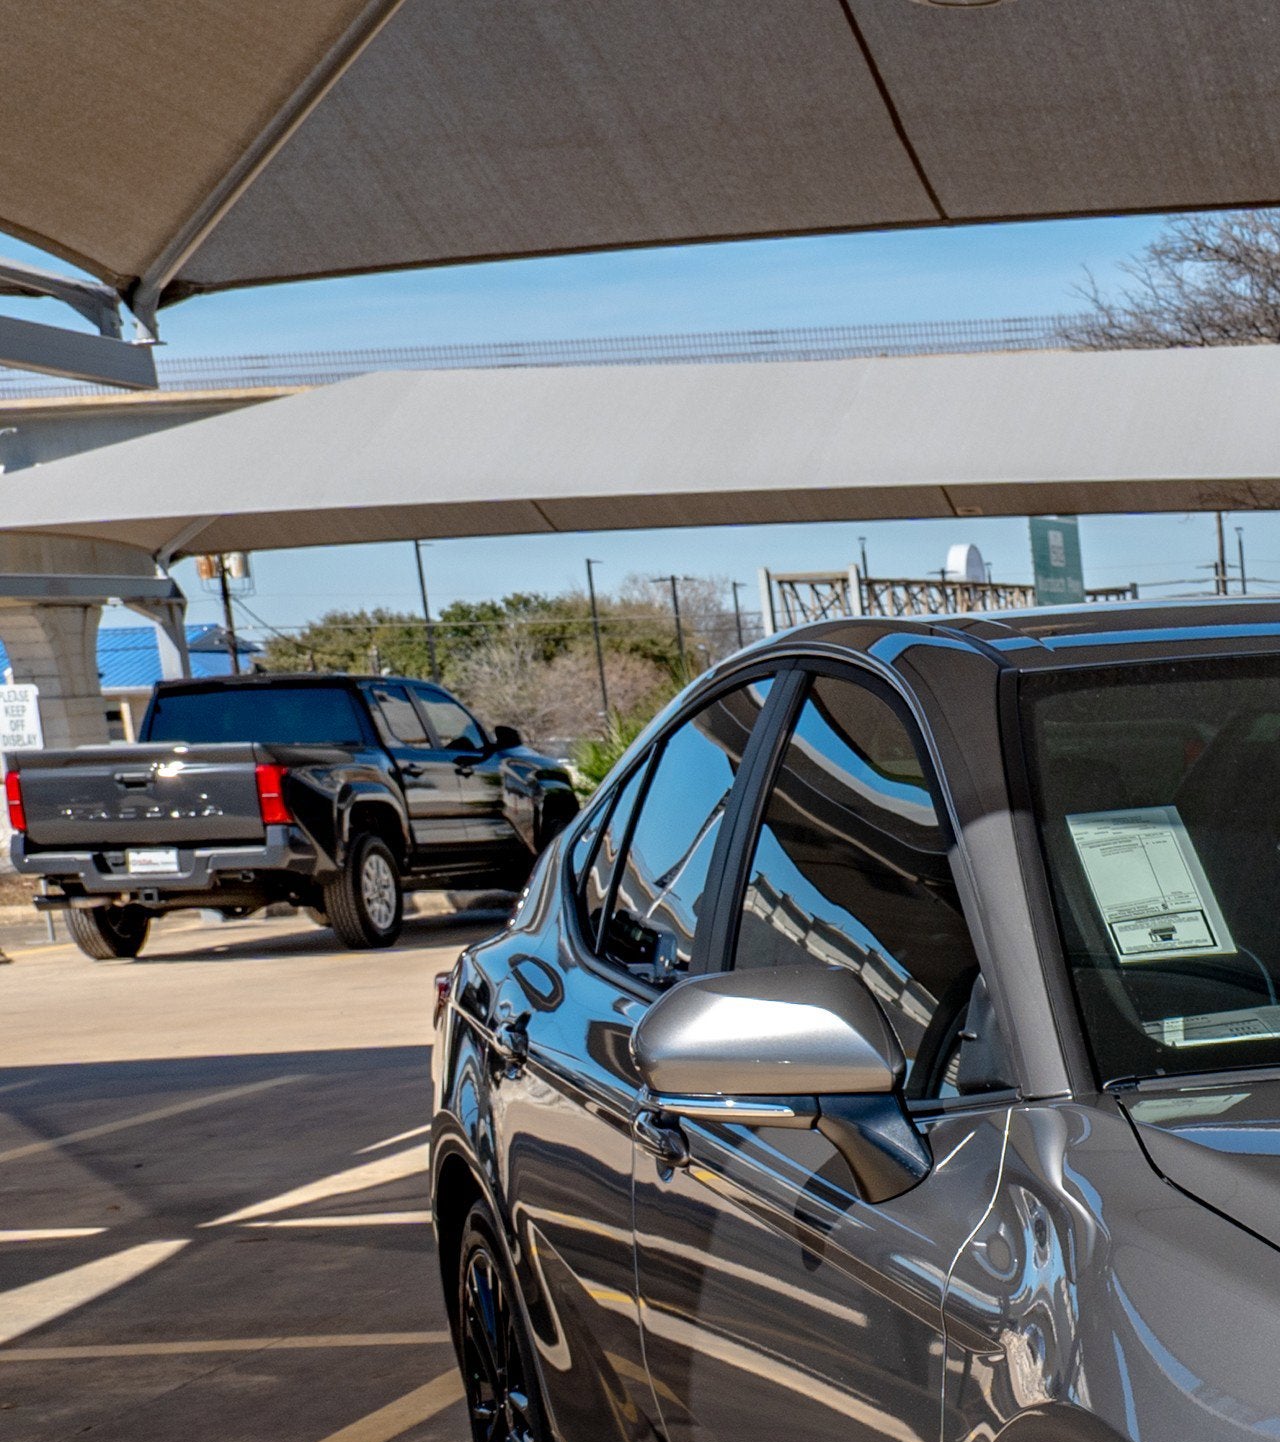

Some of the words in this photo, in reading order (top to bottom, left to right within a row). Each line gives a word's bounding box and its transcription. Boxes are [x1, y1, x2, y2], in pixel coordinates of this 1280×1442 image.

[4, 705, 27, 717] KEEP
[9, 719, 25, 731] OFF
[2, 733, 37, 746] DISPLAY
